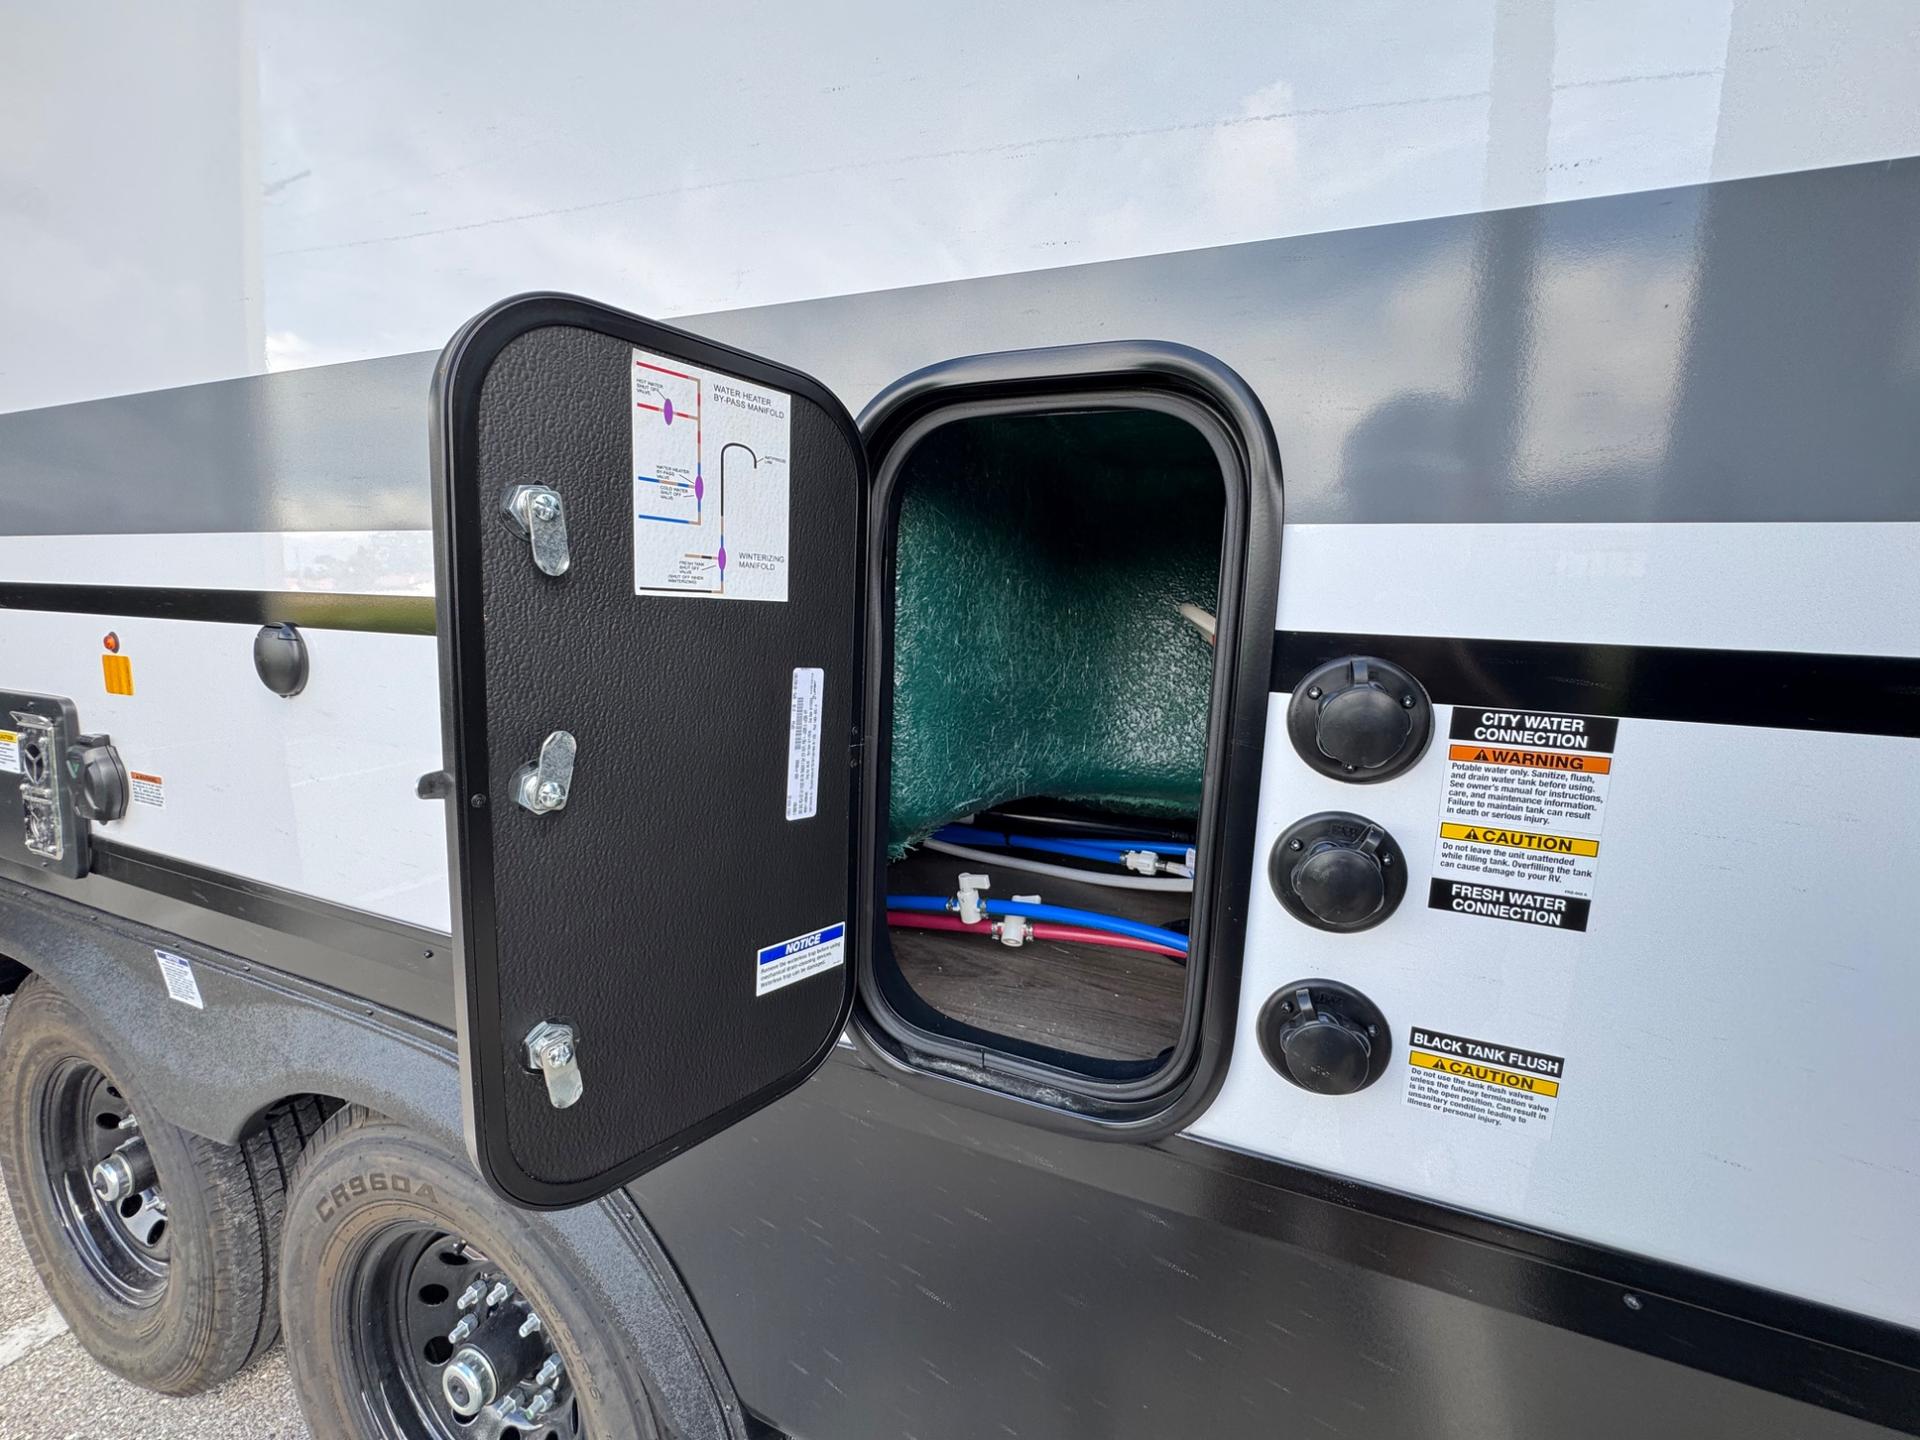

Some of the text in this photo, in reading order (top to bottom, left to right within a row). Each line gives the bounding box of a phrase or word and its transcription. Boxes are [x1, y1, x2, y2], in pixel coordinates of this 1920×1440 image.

[714, 384, 771, 405] WATER HEATER
[714, 394, 784, 418] BY-PASS MANIFOLD
[738, 552, 784, 563] WINTERIZING
[738, 561, 775, 570] MANIFOLD
[1482, 713, 1584, 732] CITY WATER
[1475, 727, 1587, 747] CONNECTION
[1493, 750, 1583, 769] WARNING
[1450, 772, 1595, 794] and drain water tank before using.
[1452, 762, 1595, 784] Potable water only. Sanitize, flush,
[1448, 790, 1596, 811] care, and maintenance information.
[1450, 780, 1603, 803] See owner's manual for instructions,
[1448, 797, 1475, 808] Failure
[1477, 800, 1485, 808] to
[1487, 803, 1523, 812] maintain
[1526, 806, 1545, 814] tank
[1565, 811, 1591, 820] result
[1456, 807, 1479, 816] death
[1492, 812, 1522, 821] serious
[1524, 814, 1550, 825] injury.
[1483, 830, 1573, 851] CAUTION
[1442, 852, 1592, 878] while filling tank. Overfilling the tank
[1443, 842, 1453, 850] Do
[1470, 846, 1491, 855] leave
[1493, 849, 1507, 857] the
[1527, 855, 1575, 866] unattended
[1457, 863, 1481, 872] cause
[1482, 866, 1515, 877] damage
[1517, 870, 1526, 878] to
[1548, 874, 1562, 883] RV.
[1452, 884, 1566, 911] FRESH WATER
[1452, 899, 1561, 925] CONNECTION
[785, 934, 822, 954] NOTICE
[1413, 1033, 1559, 1073] BLACK TANK FLUSH
[1411, 1067, 1422, 1075] Do
[1424, 1070, 1435, 1078] not
[1453, 1076, 1465, 1085] the
[1468, 1080, 1484, 1089] tank
[1487, 1084, 1506, 1094] flush
[1509, 1091, 1533, 1101] valves
[1450, 1062, 1534, 1090] CAUTION
[1410, 1076, 1549, 1113] unless the fullway termination valve
[1427, 1086, 1438, 1095] the
[1441, 1091, 1459, 1101] open
[1462, 1095, 1494, 1108] position.
[1496, 1103, 1511, 1112] Can
[1513, 1108, 1537, 1118] result
[1538, 1112, 1546, 1120] in
[1407, 1098, 1431, 1108] illness
[1443, 1106, 1476, 1119] personal
[1477, 1114, 1502, 1126] injury.
[1408, 1091, 1526, 1123] unsanitary condition leading to
[314, 1172, 440, 1224] CR960A
